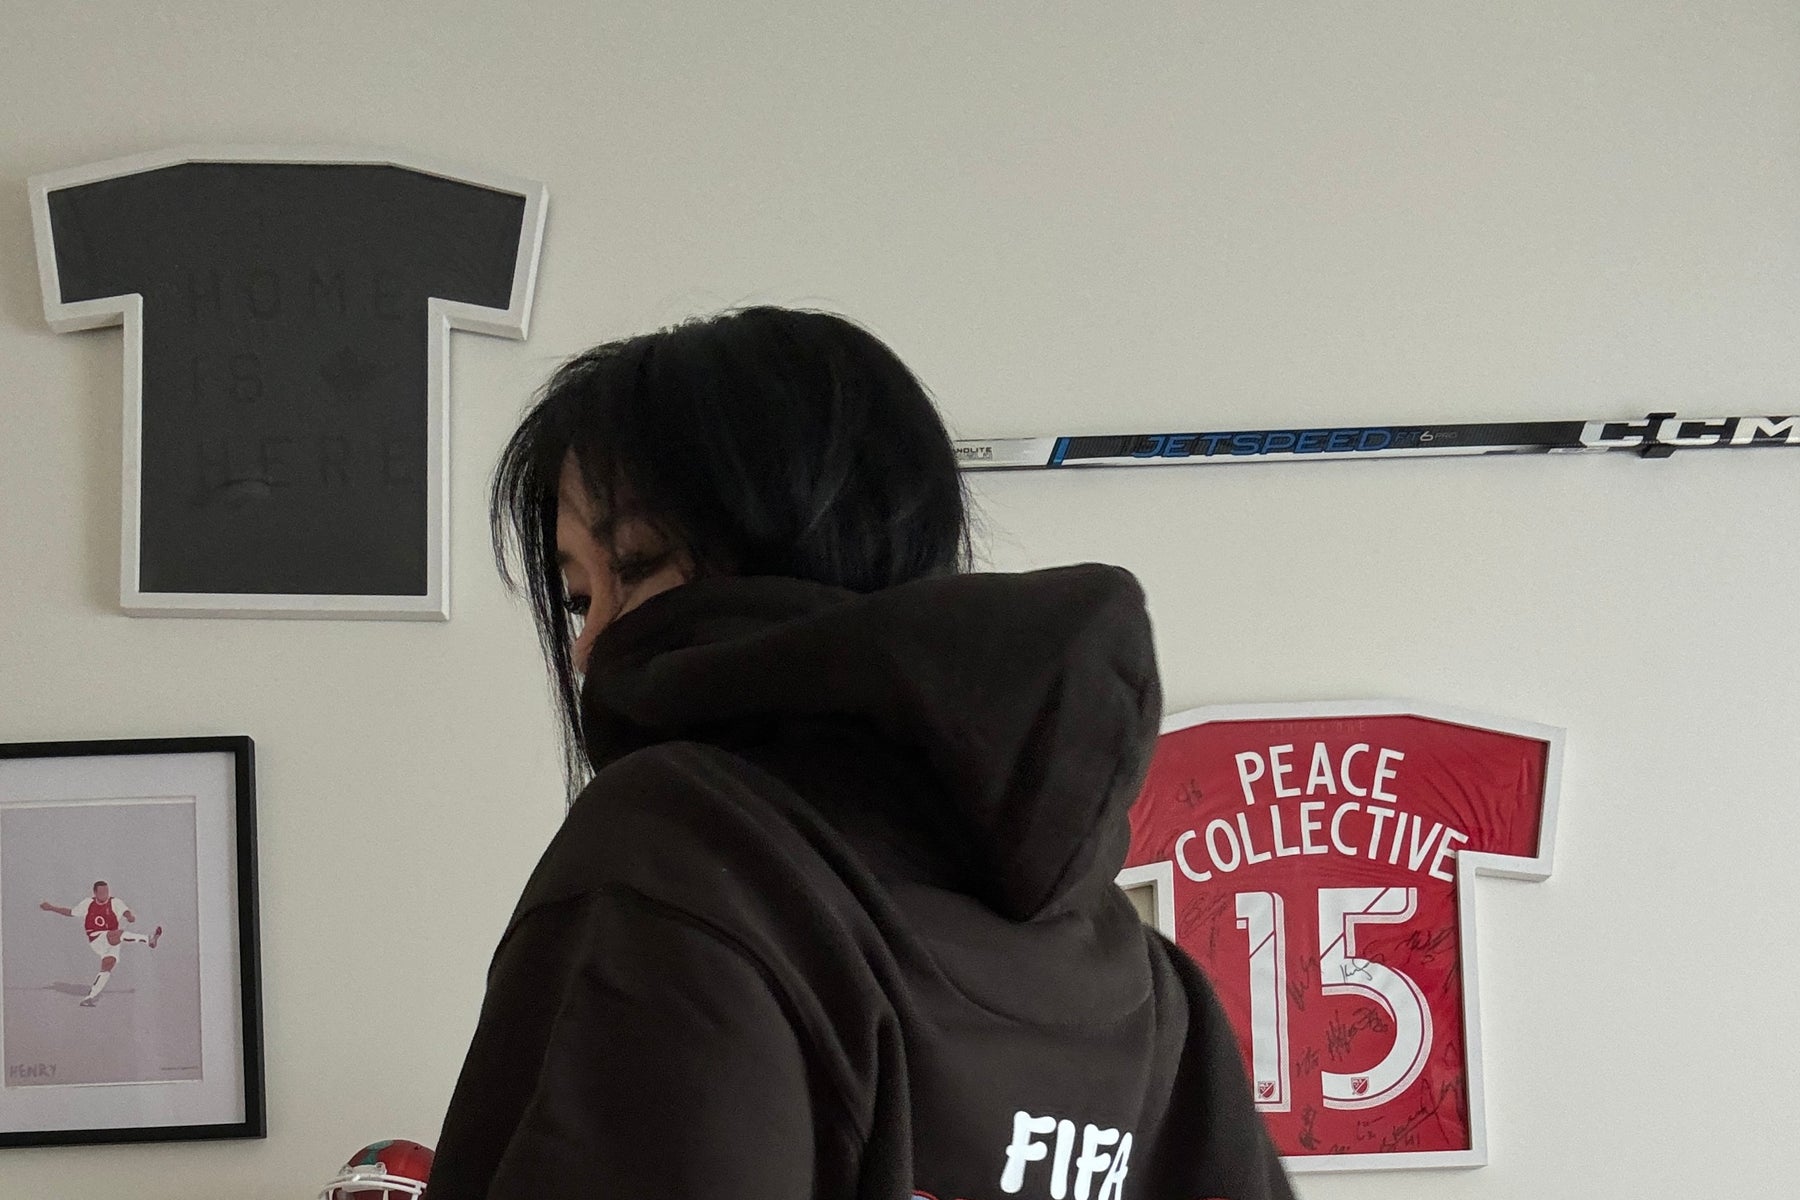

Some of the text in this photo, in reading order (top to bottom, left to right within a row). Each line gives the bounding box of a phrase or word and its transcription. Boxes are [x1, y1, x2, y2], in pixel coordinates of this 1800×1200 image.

[1131, 430, 1392, 458] JETSPEED
[1579, 416, 1800, 446] CCM
[1235, 742, 1405, 806] PEACE
[1174, 801, 1469, 883] COLLECTIVE
[1235, 887, 1433, 1113] 15
[10, 1063, 57, 1078] HENRY
